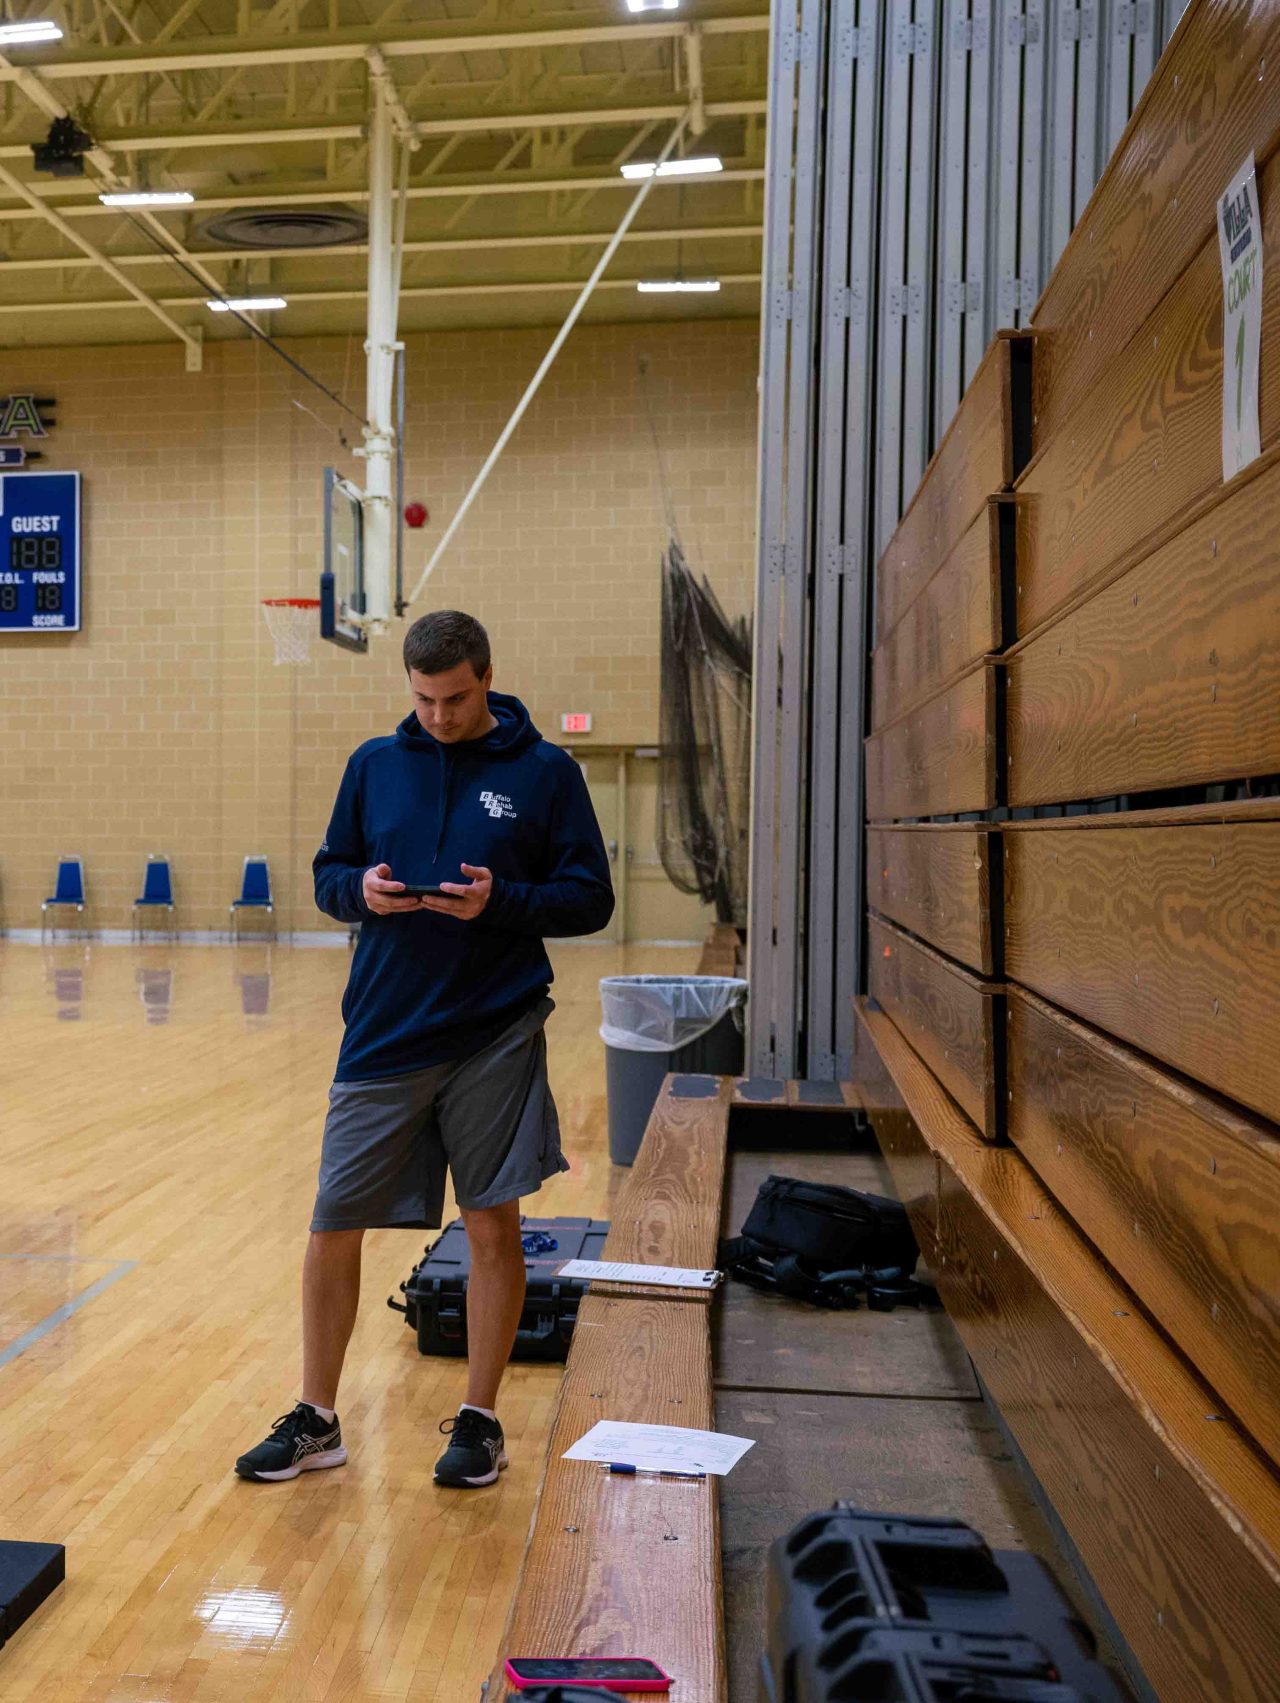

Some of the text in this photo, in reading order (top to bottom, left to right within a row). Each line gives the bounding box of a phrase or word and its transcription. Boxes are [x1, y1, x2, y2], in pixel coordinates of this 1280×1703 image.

[1223, 185, 1253, 246] VILLA
[11, 515, 60, 533] GUEST
[32, 571, 66, 584] FOULS
[32, 614, 65, 627] SCORE
[482, 792, 510, 802] Buffalo
[486, 801, 513, 810] Rehab
[491, 808, 517, 818] Group
